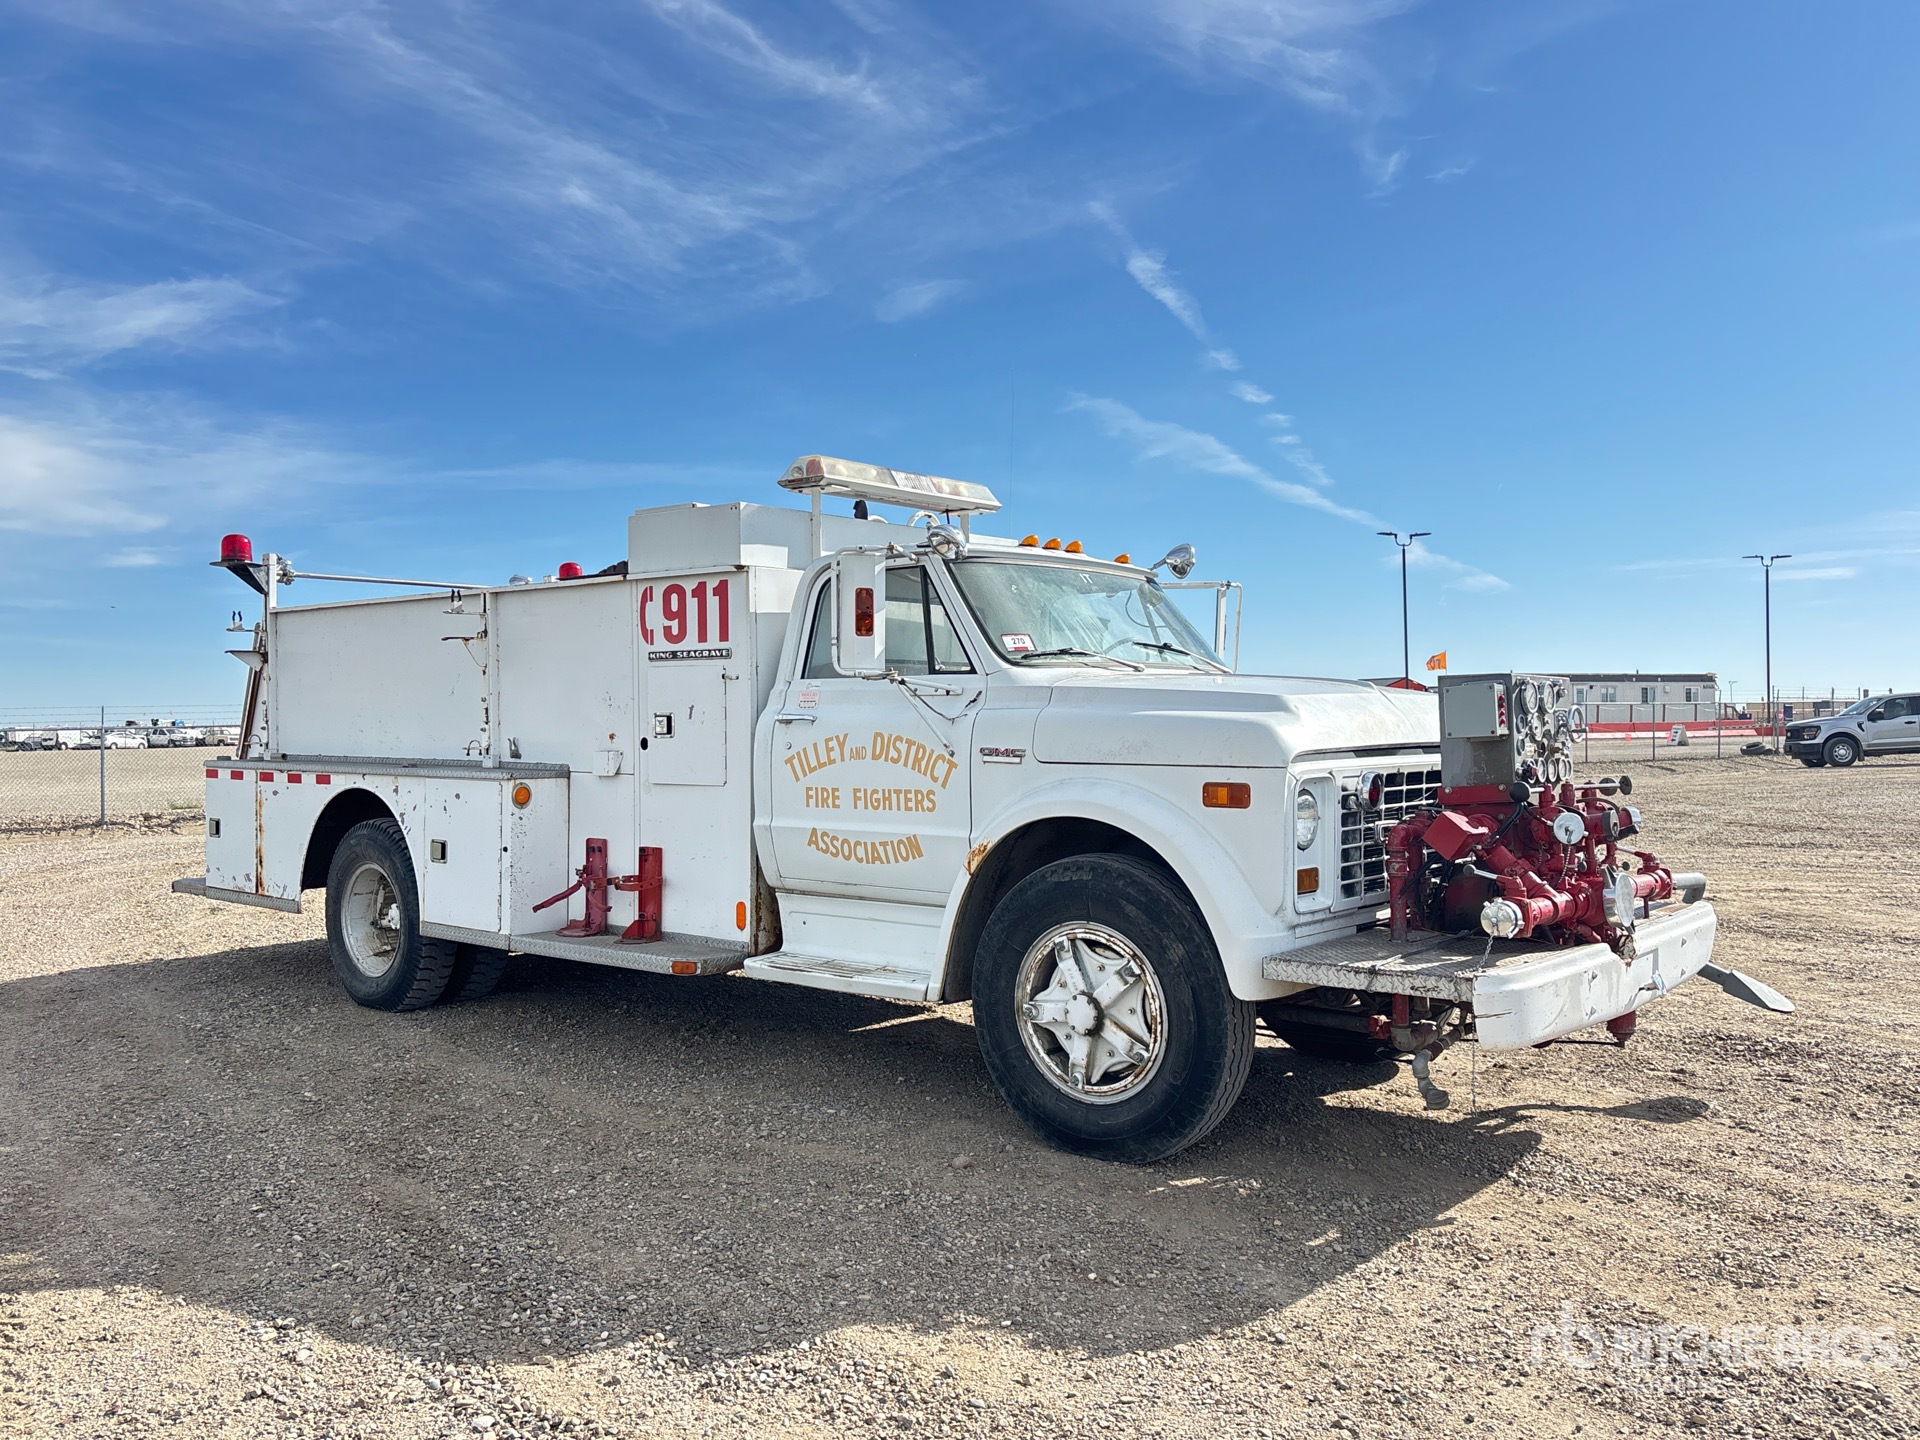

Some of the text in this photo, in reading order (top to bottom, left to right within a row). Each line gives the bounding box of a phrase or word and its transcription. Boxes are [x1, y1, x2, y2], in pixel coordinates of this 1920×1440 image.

[662, 579, 729, 644] 911
[1011, 637, 1026, 645] 270
[649, 649, 729, 660] KING SEAGRAVE
[785, 732, 958, 790] TILLEY AND DISTRICT
[979, 747, 1027, 758] GMC
[805, 786, 936, 812] FIRE FIGHTERS
[808, 827, 923, 864] ASSOCIATION
